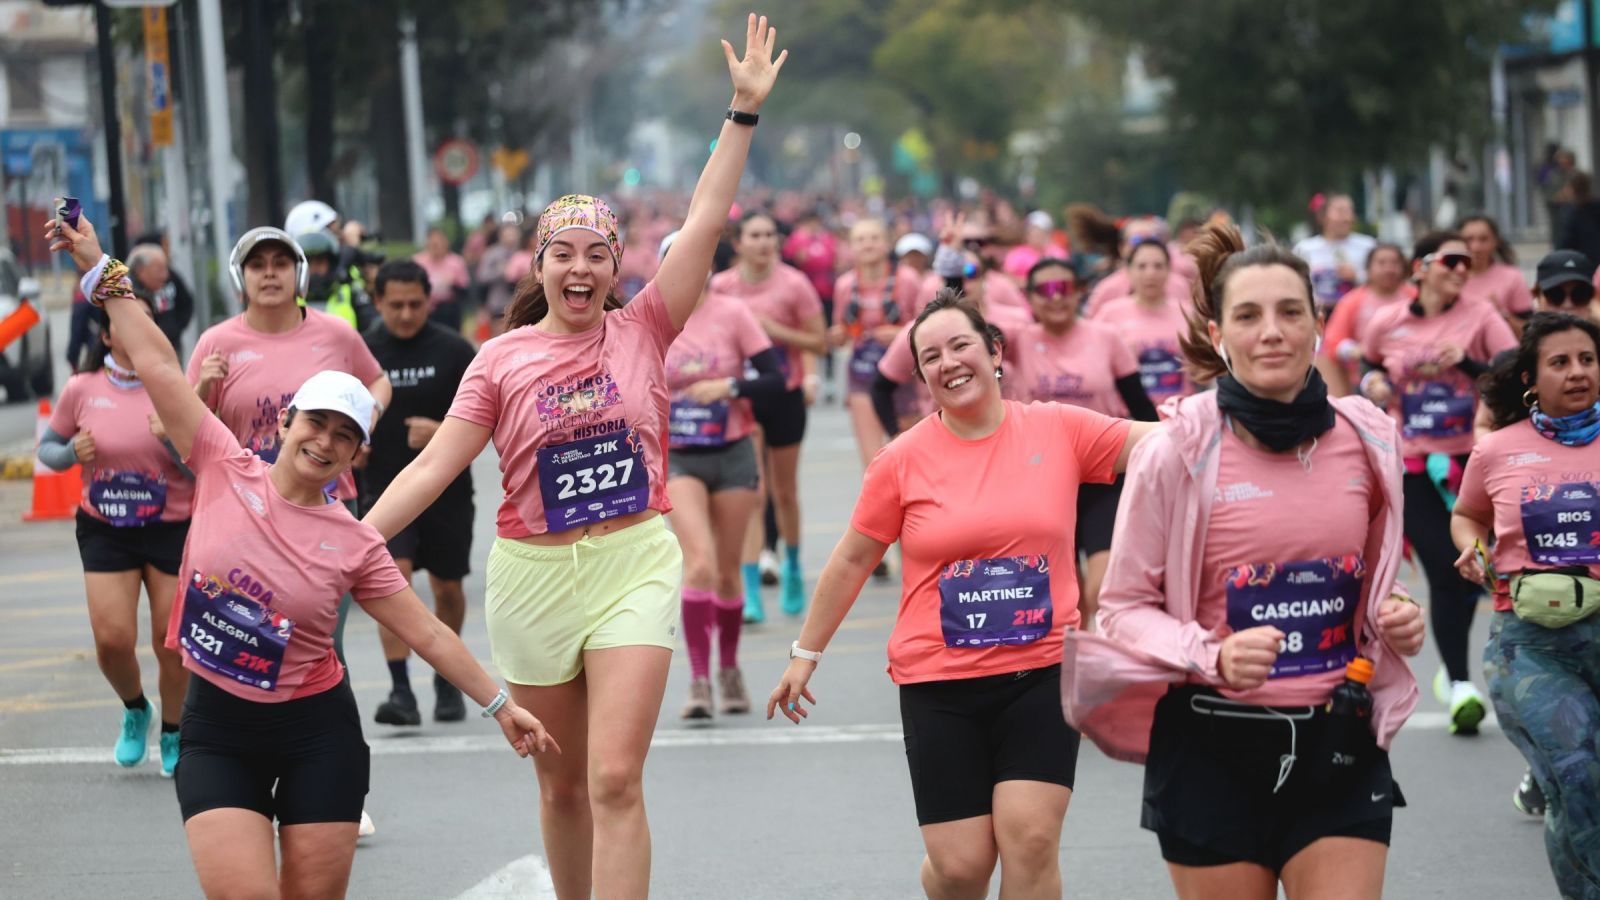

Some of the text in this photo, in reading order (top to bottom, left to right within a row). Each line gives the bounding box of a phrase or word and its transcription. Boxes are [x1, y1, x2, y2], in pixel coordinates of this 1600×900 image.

[402, 365, 436, 379] TEAM
[544, 411, 603, 433] HACEMOS
[573, 417, 627, 441] HISTORIA
[594, 439, 618, 456] 21K
[556, 457, 634, 500] 2327
[1557, 511, 1592, 523] RIOS
[1535, 532, 1578, 547] 1245
[227, 568, 274, 607] CADA
[958, 586, 1034, 604] MARTINEZ
[966, 607, 1047, 629] 17 21K
[1251, 597, 1344, 621] CASCIANO
[202, 611, 259, 647] ALEGRIA
[190, 623, 274, 674] 1221 21K
